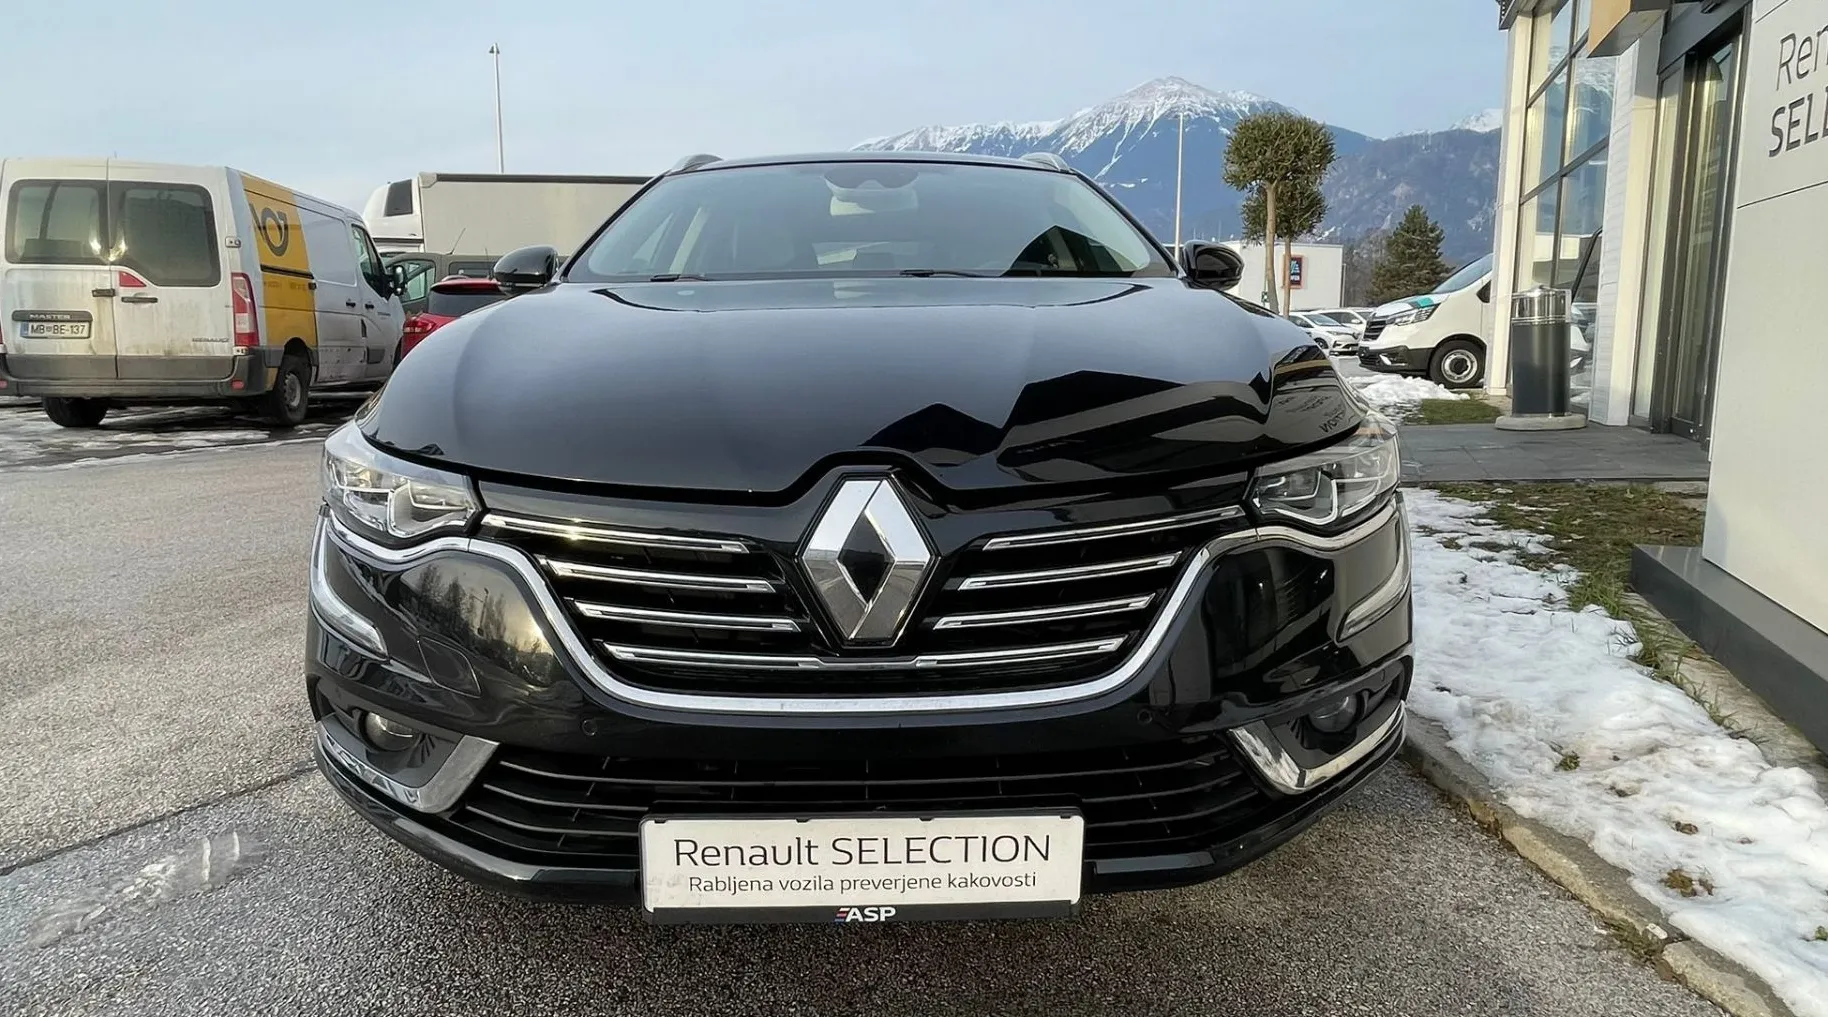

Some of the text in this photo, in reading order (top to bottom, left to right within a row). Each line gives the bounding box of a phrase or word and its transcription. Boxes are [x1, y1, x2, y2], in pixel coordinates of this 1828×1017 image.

[674, 834, 1050, 867] Renault SELECTION
[689, 872, 1036, 896] Rabljena vozila preverjene kakovosti
[845, 906, 896, 923] ASP
